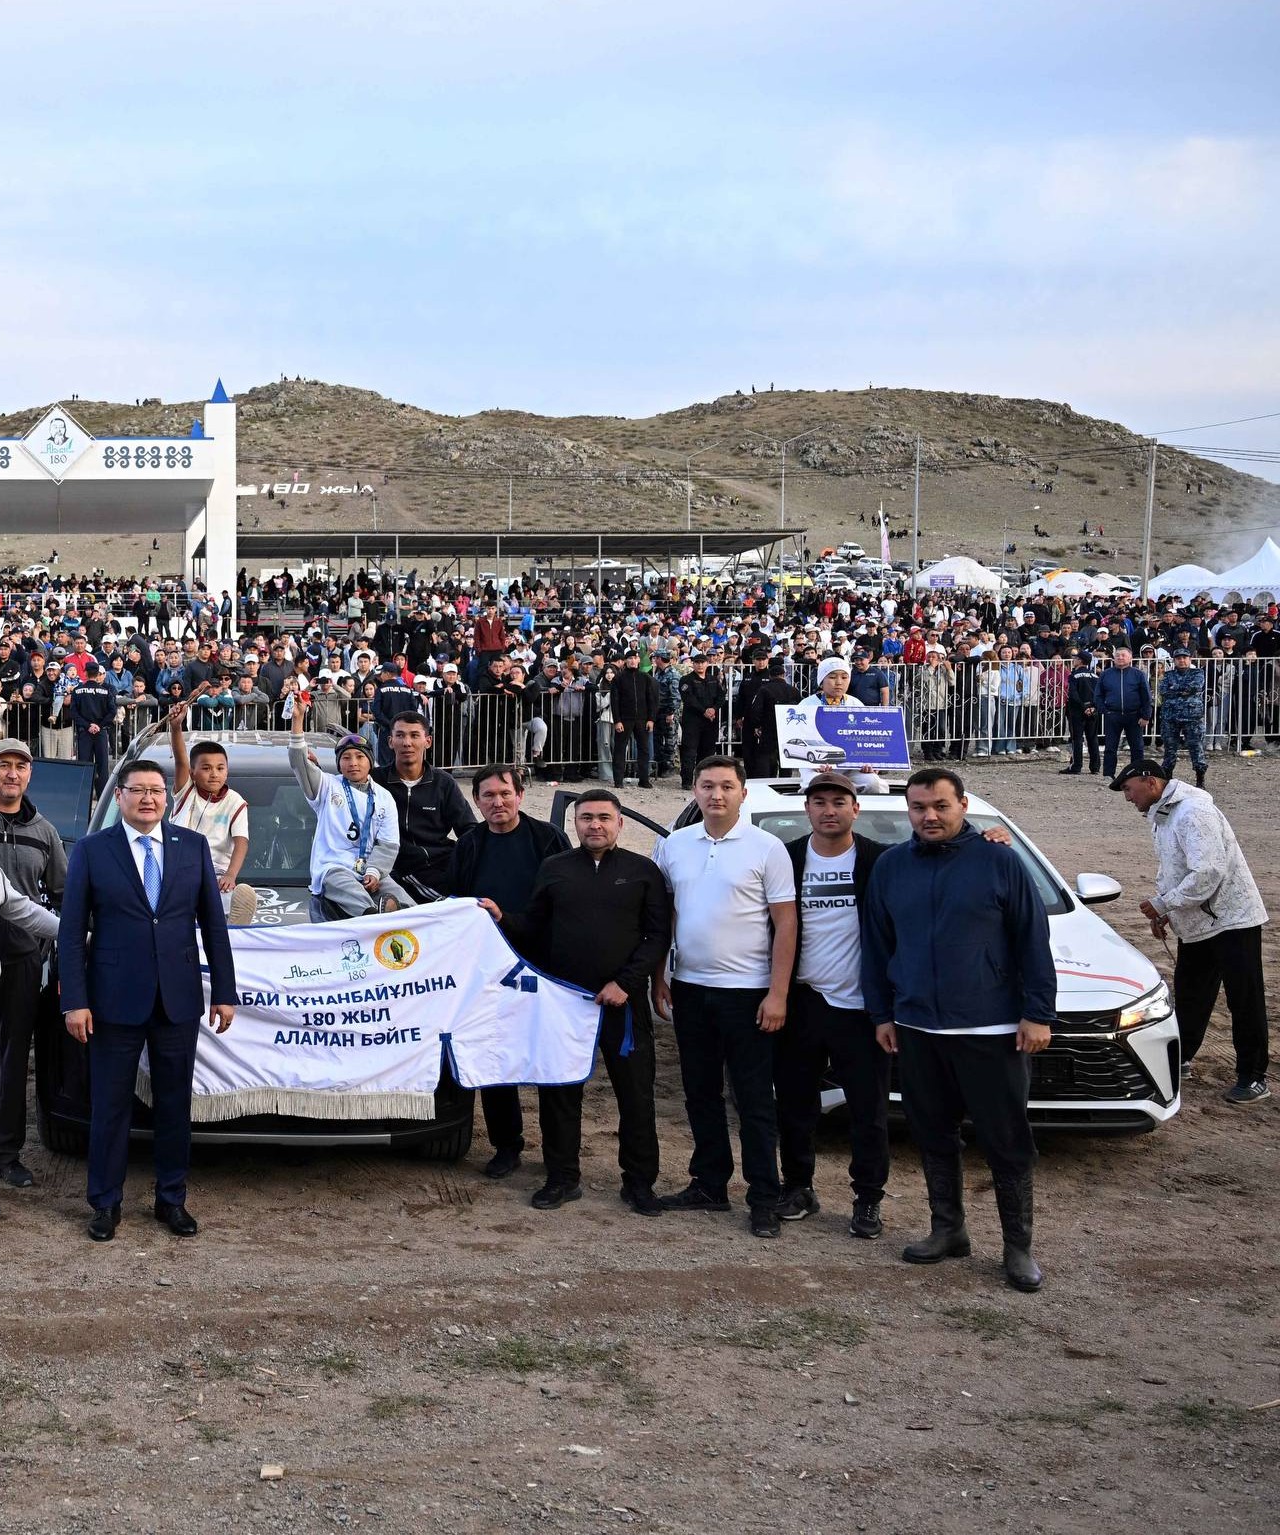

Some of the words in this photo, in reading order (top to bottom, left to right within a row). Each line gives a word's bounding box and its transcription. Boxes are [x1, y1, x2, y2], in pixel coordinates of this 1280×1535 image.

[50, 454, 68, 464] 180
[260, 483, 310, 494] 180
[837, 729, 893, 737] СЕРТИФИКАТ
[346, 821, 360, 841] 5
[803, 871, 854, 882] NDE
[801, 899, 856, 909] ARMOU
[348, 969, 367, 981] 180
[286, 975, 457, 1008] ҚҰНАНБАЙҰЛЫНА
[302, 1012, 336, 1027] 180
[341, 1007, 391, 1026] ЖЫЛ
[274, 1030, 355, 1047] АЛАМАН
[361, 1026, 422, 1047] БӘЙГЕ
